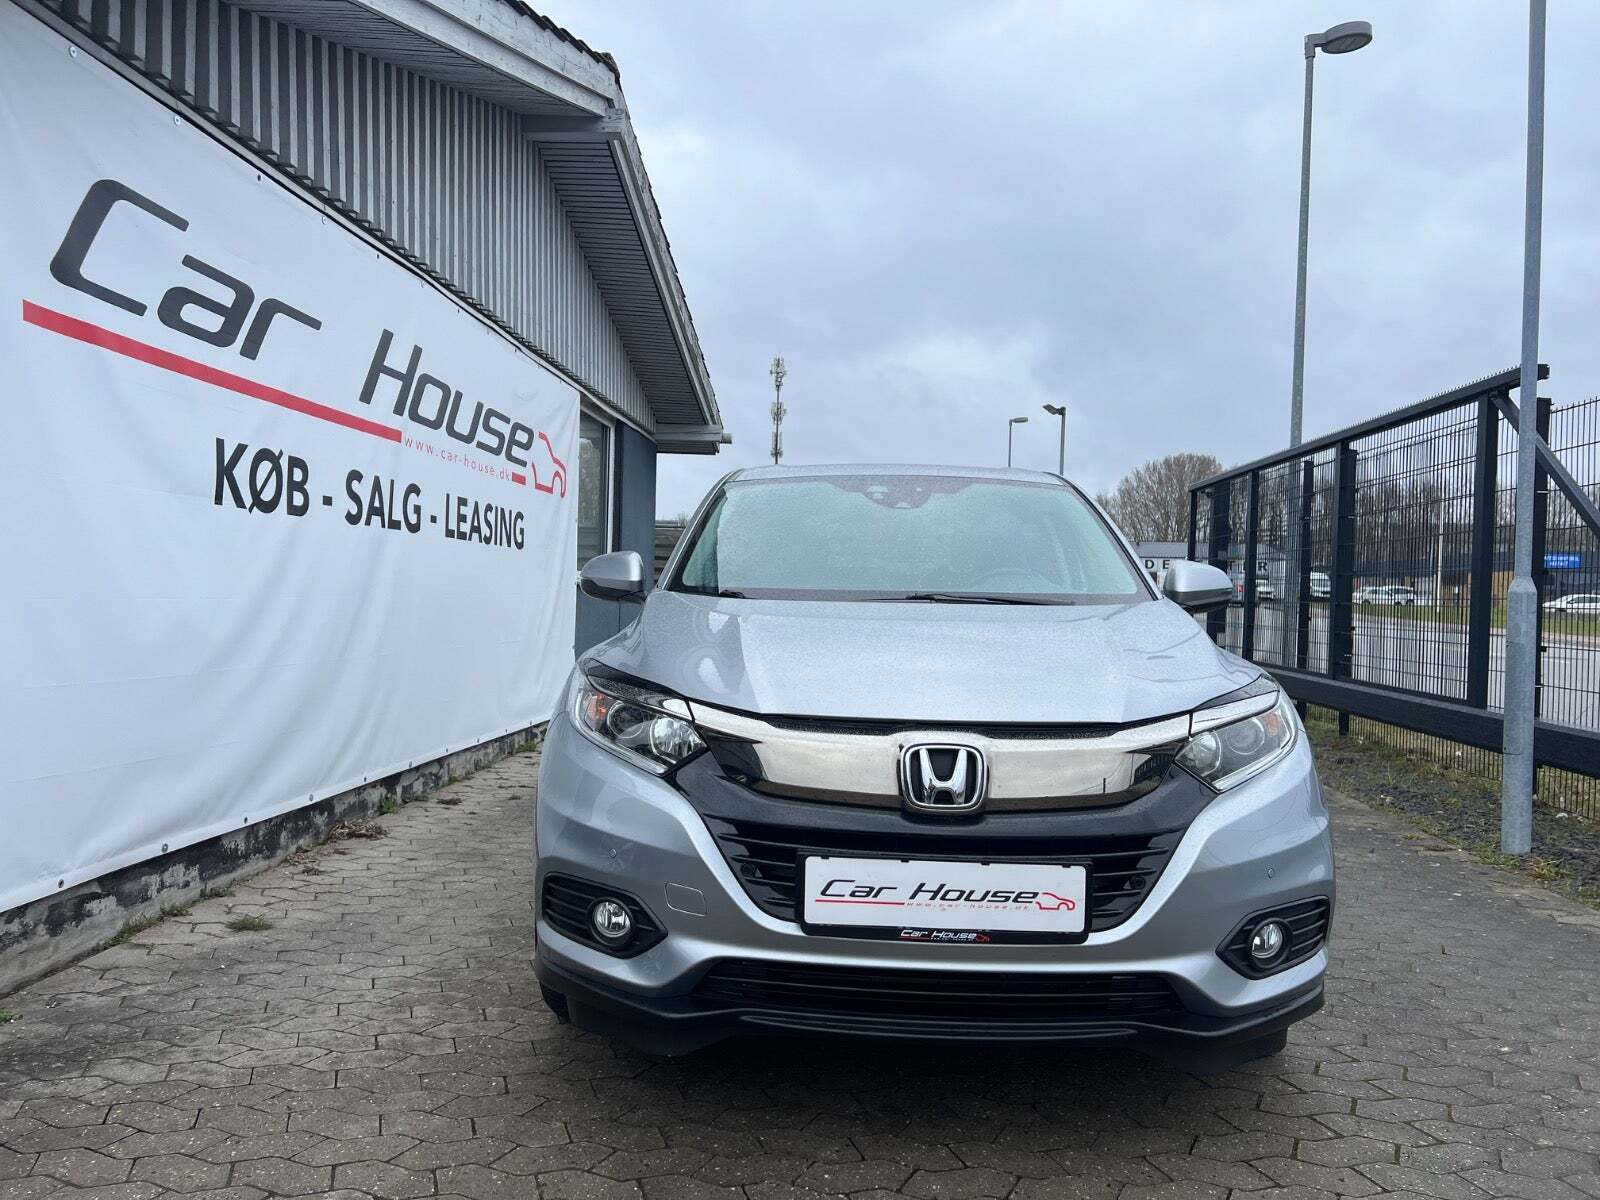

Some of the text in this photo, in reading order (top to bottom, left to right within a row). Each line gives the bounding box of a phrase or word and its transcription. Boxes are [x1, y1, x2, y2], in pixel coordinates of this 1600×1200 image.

[50, 178, 535, 467] Car House
[403, 435, 511, 482] www.car-house.dk
[214, 437, 310, 517] KØB
[344, 469, 422, 534] SALG
[444, 493, 526, 549] LEASING
[820, 878, 1039, 904] Car House
[900, 929, 928, 938] Car
[931, 930, 977, 940] House
